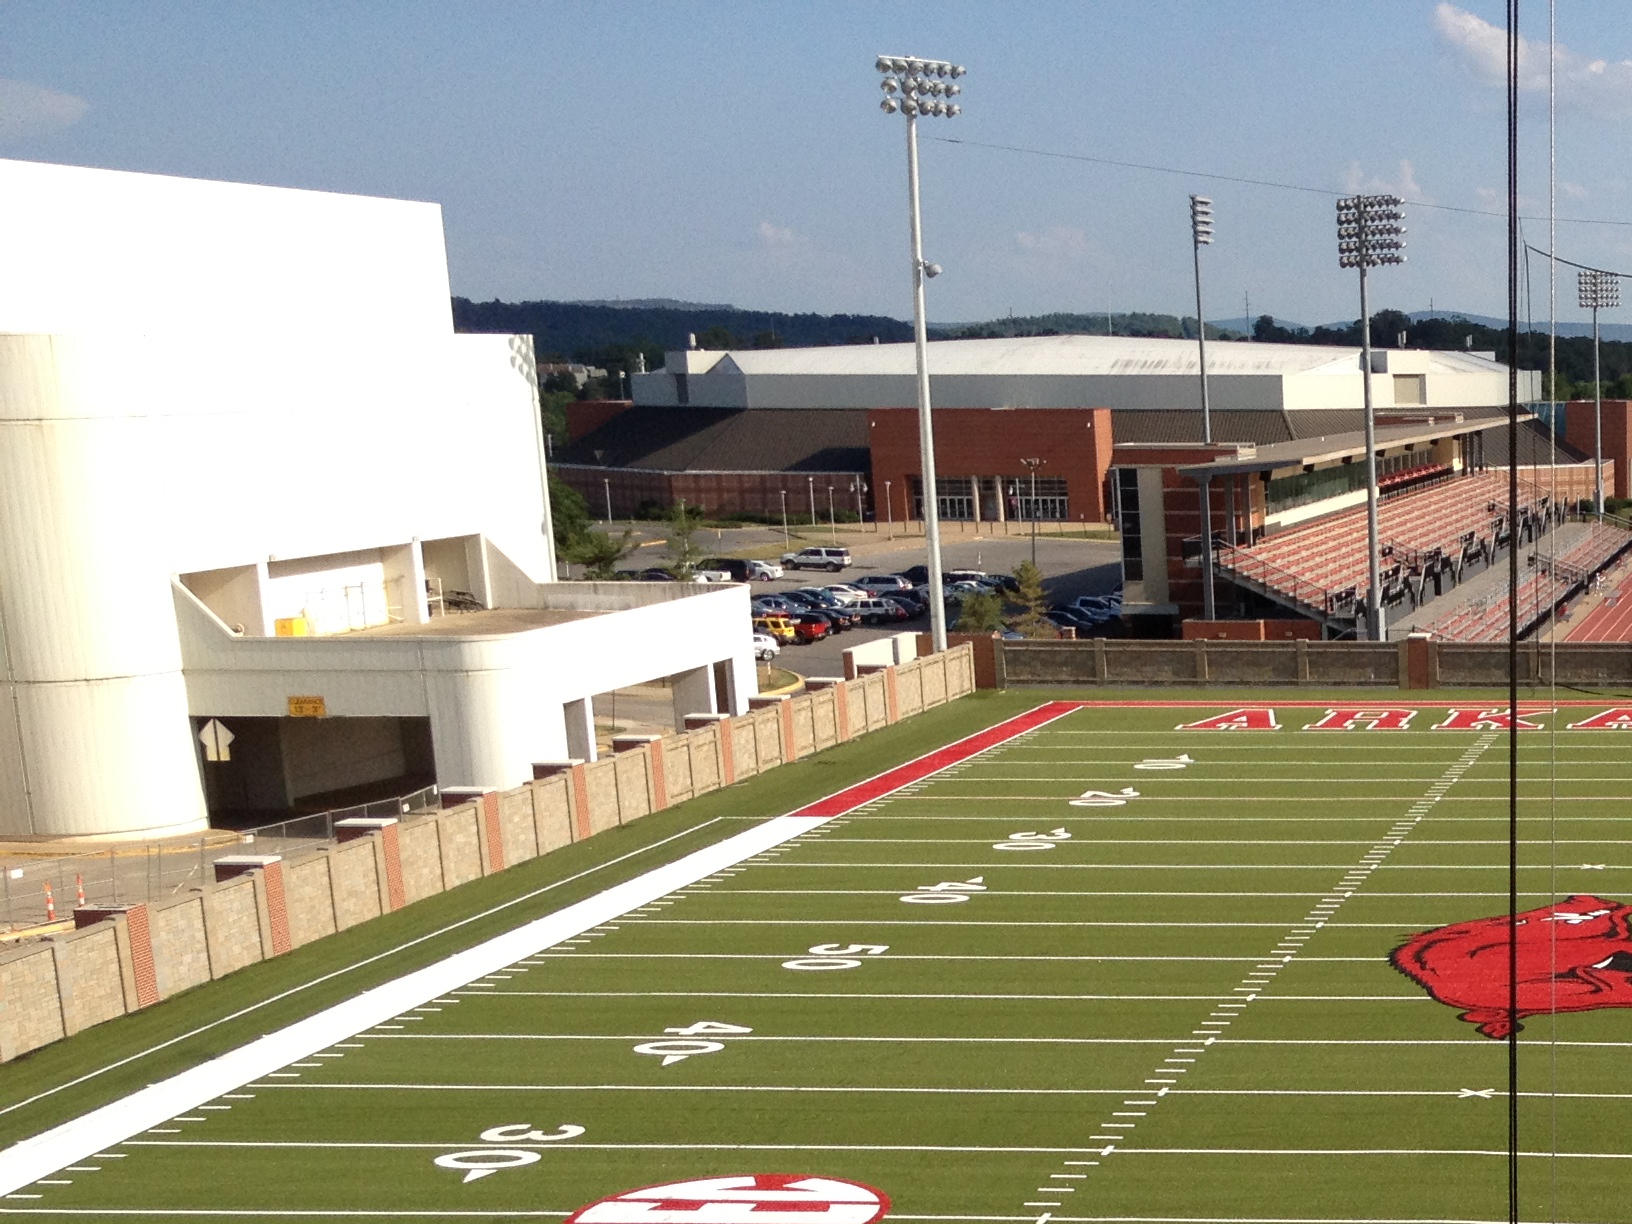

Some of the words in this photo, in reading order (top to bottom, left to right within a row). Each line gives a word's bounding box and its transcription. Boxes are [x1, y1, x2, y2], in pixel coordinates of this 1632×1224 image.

[899, 881, 988, 903] 40
[781, 943, 890, 970] 50
[632, 1020, 754, 1056] 40
[433, 1124, 587, 1171] 30
